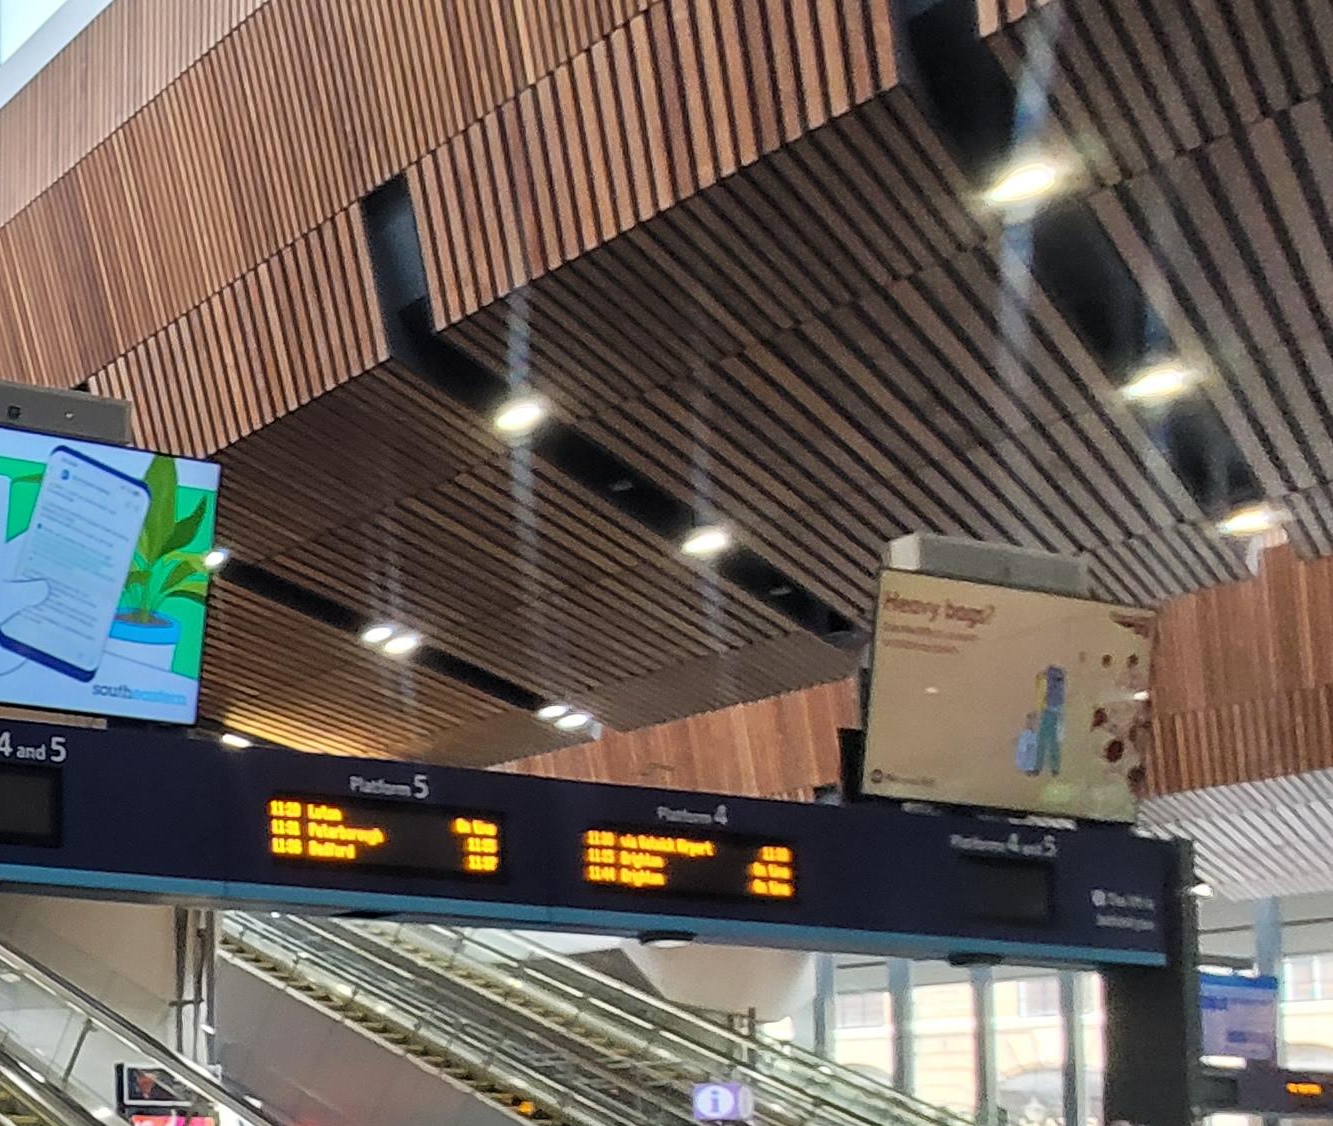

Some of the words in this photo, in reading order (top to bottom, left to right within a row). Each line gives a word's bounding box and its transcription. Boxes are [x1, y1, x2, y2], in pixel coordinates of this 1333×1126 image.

[16, 743, 47, 761] and
[49, 736, 68, 763] 5
[349, 776, 412, 797] Platform
[413, 774, 430, 799] 5
